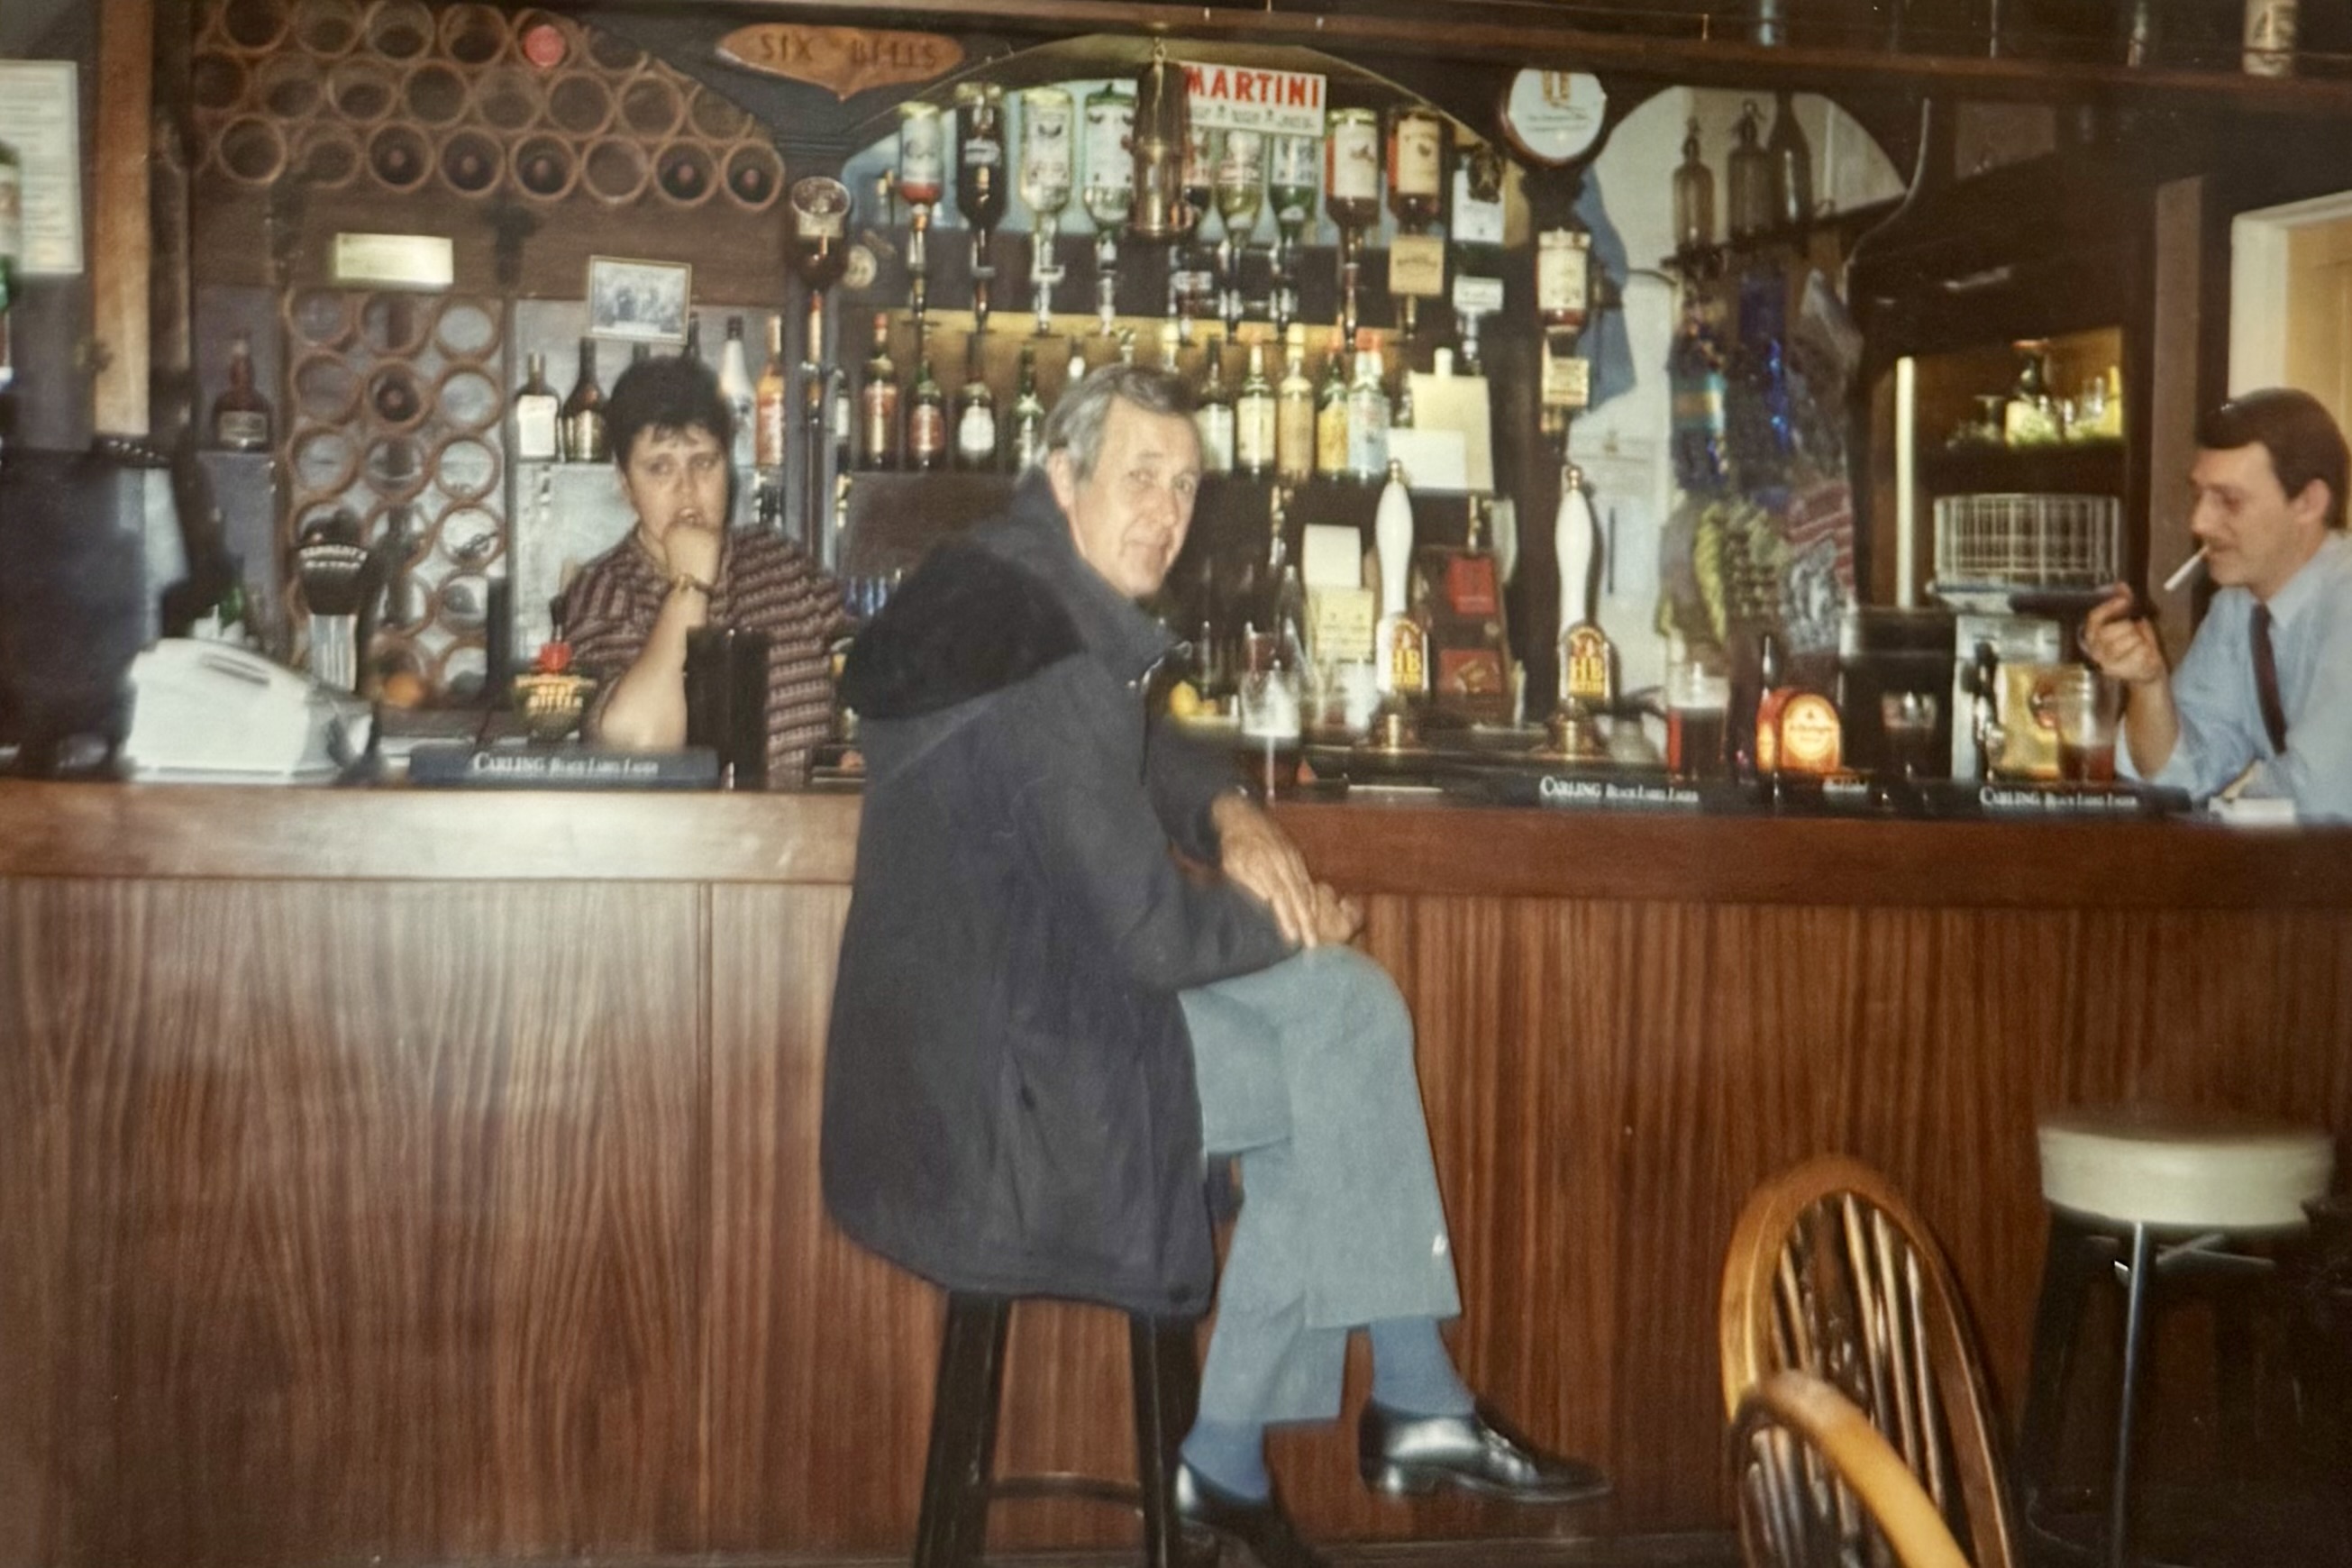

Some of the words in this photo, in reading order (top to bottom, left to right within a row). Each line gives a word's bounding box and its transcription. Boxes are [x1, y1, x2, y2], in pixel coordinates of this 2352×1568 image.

[760, 33, 813, 62] SIX
[1183, 66, 1320, 109] MARTINI
[473, 752, 544, 773] CARLING
[1539, 775, 1602, 798] CARLING
[1979, 787, 2040, 807] CARLING
